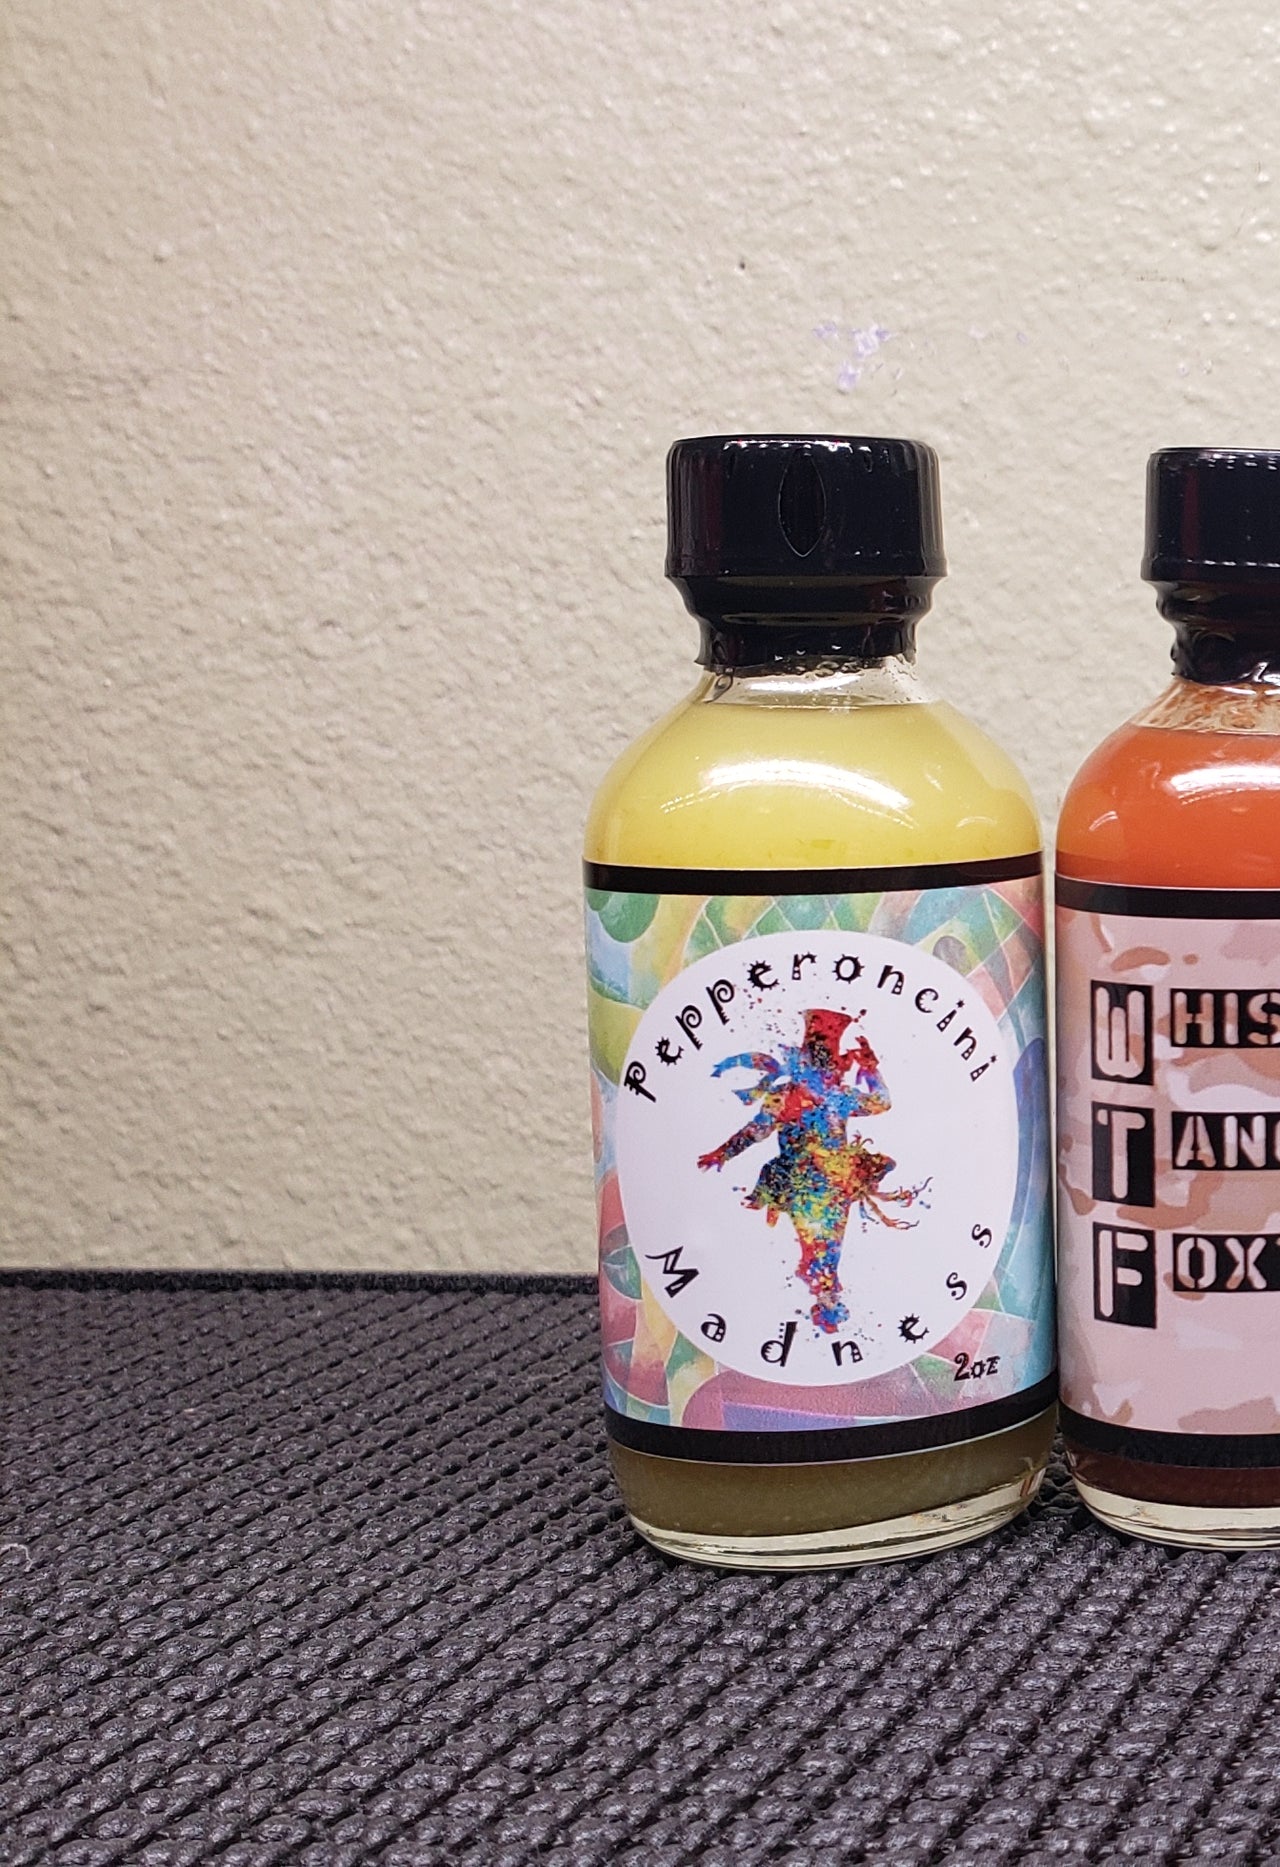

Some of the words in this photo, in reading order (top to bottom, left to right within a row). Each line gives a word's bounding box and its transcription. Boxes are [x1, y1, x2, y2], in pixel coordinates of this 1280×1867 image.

[623, 950, 997, 1103] Pepperoncini
[644, 1221, 993, 1368] Madness
[953, 1351, 1001, 1383] 2oz
